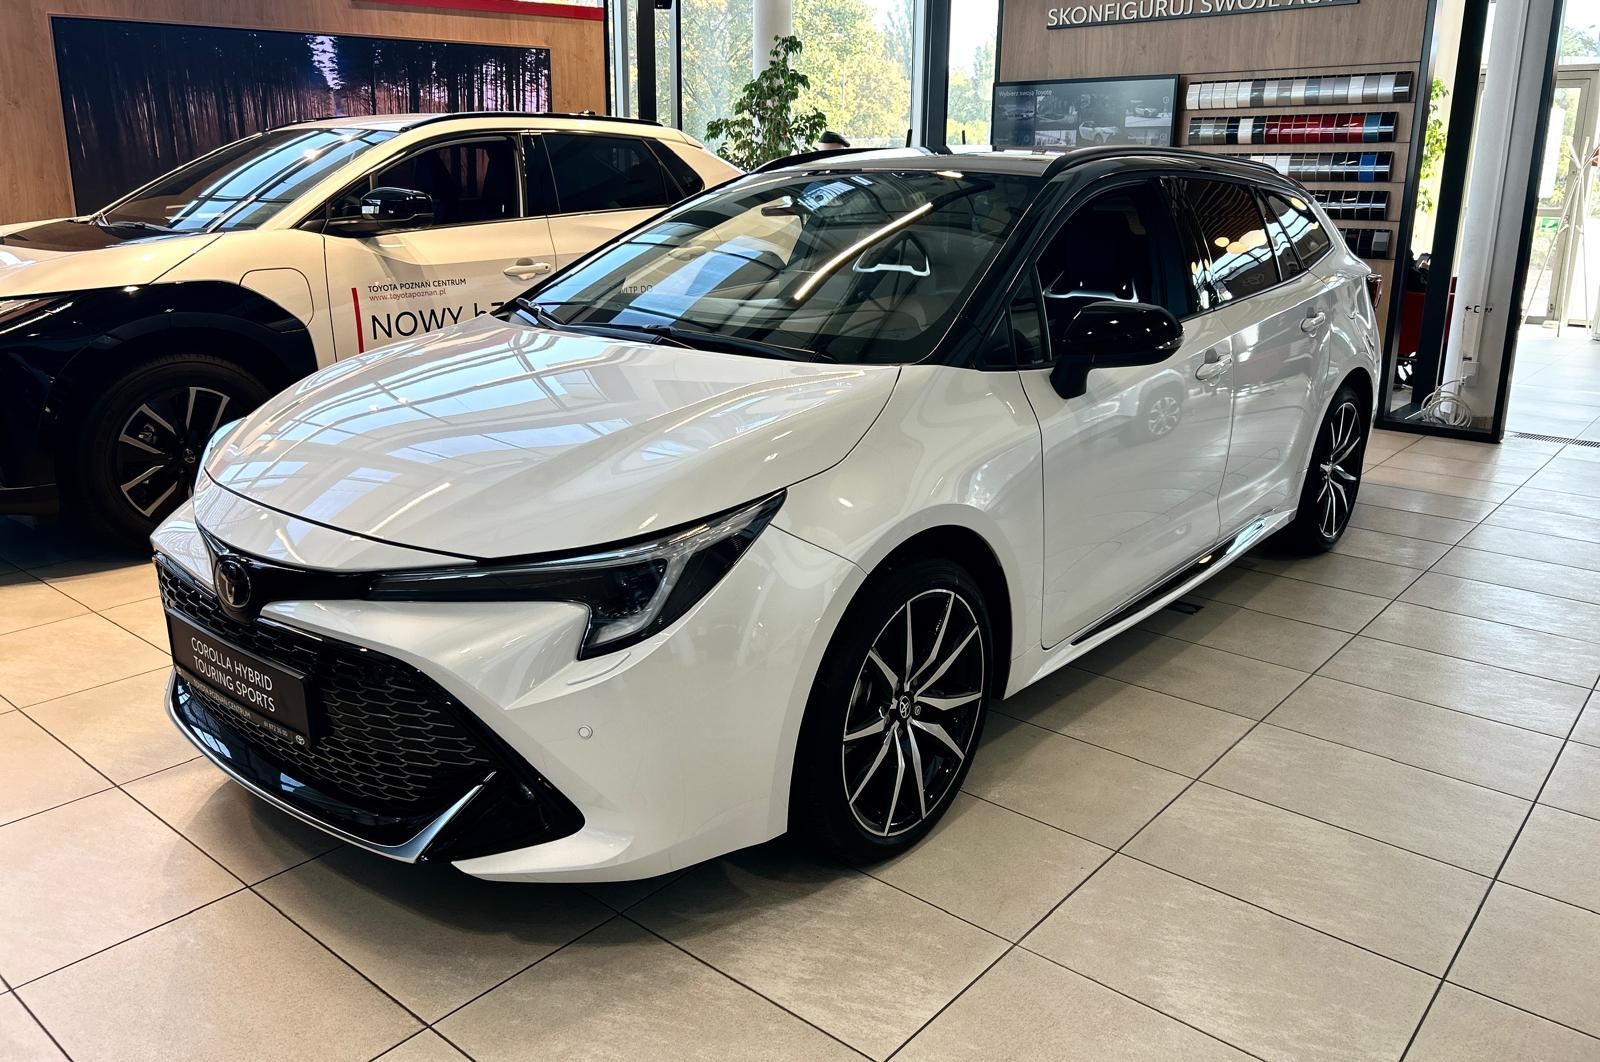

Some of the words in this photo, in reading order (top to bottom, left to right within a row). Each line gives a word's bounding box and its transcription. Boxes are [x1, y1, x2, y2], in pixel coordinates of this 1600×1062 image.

[1047, 0, 1193, 26] SKONFIGURUJ
[368, 283, 398, 293] TOYOTA
[399, 280, 431, 290] POZNAŃ
[432, 278, 467, 287] CENTRUM
[369, 288, 447, 301] www.toyotapoznan.pl
[371, 306, 463, 340] NOWY
[474, 302, 505, 318] b
[191, 637, 233, 672] COROLLA
[234, 660, 273, 691] HYBRID
[193, 655, 234, 692] TOURING
[236, 680, 276, 712] SPORTS
